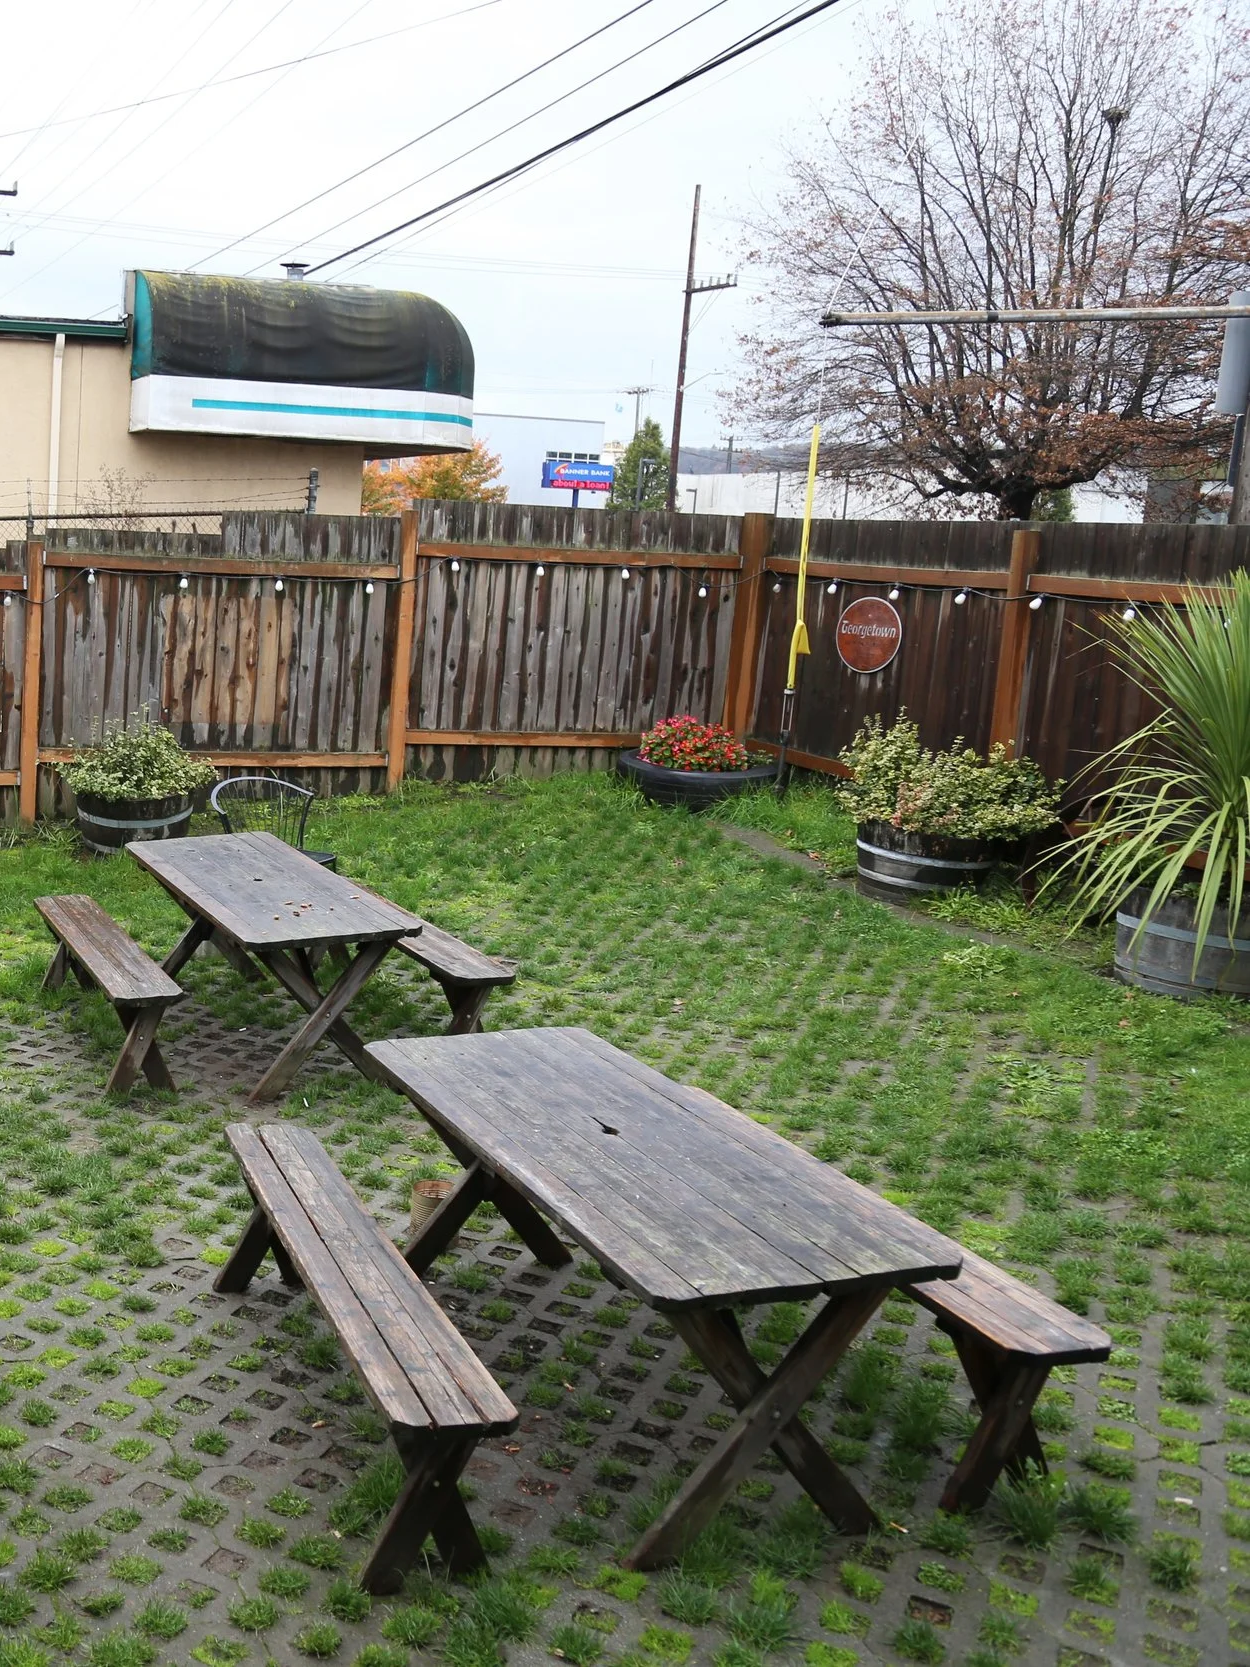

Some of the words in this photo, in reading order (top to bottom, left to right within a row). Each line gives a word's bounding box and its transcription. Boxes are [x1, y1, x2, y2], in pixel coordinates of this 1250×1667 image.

[560, 467, 589, 475] BANNER
[553, 479, 578, 488] about
[841, 620, 897, 639] Georgetown
